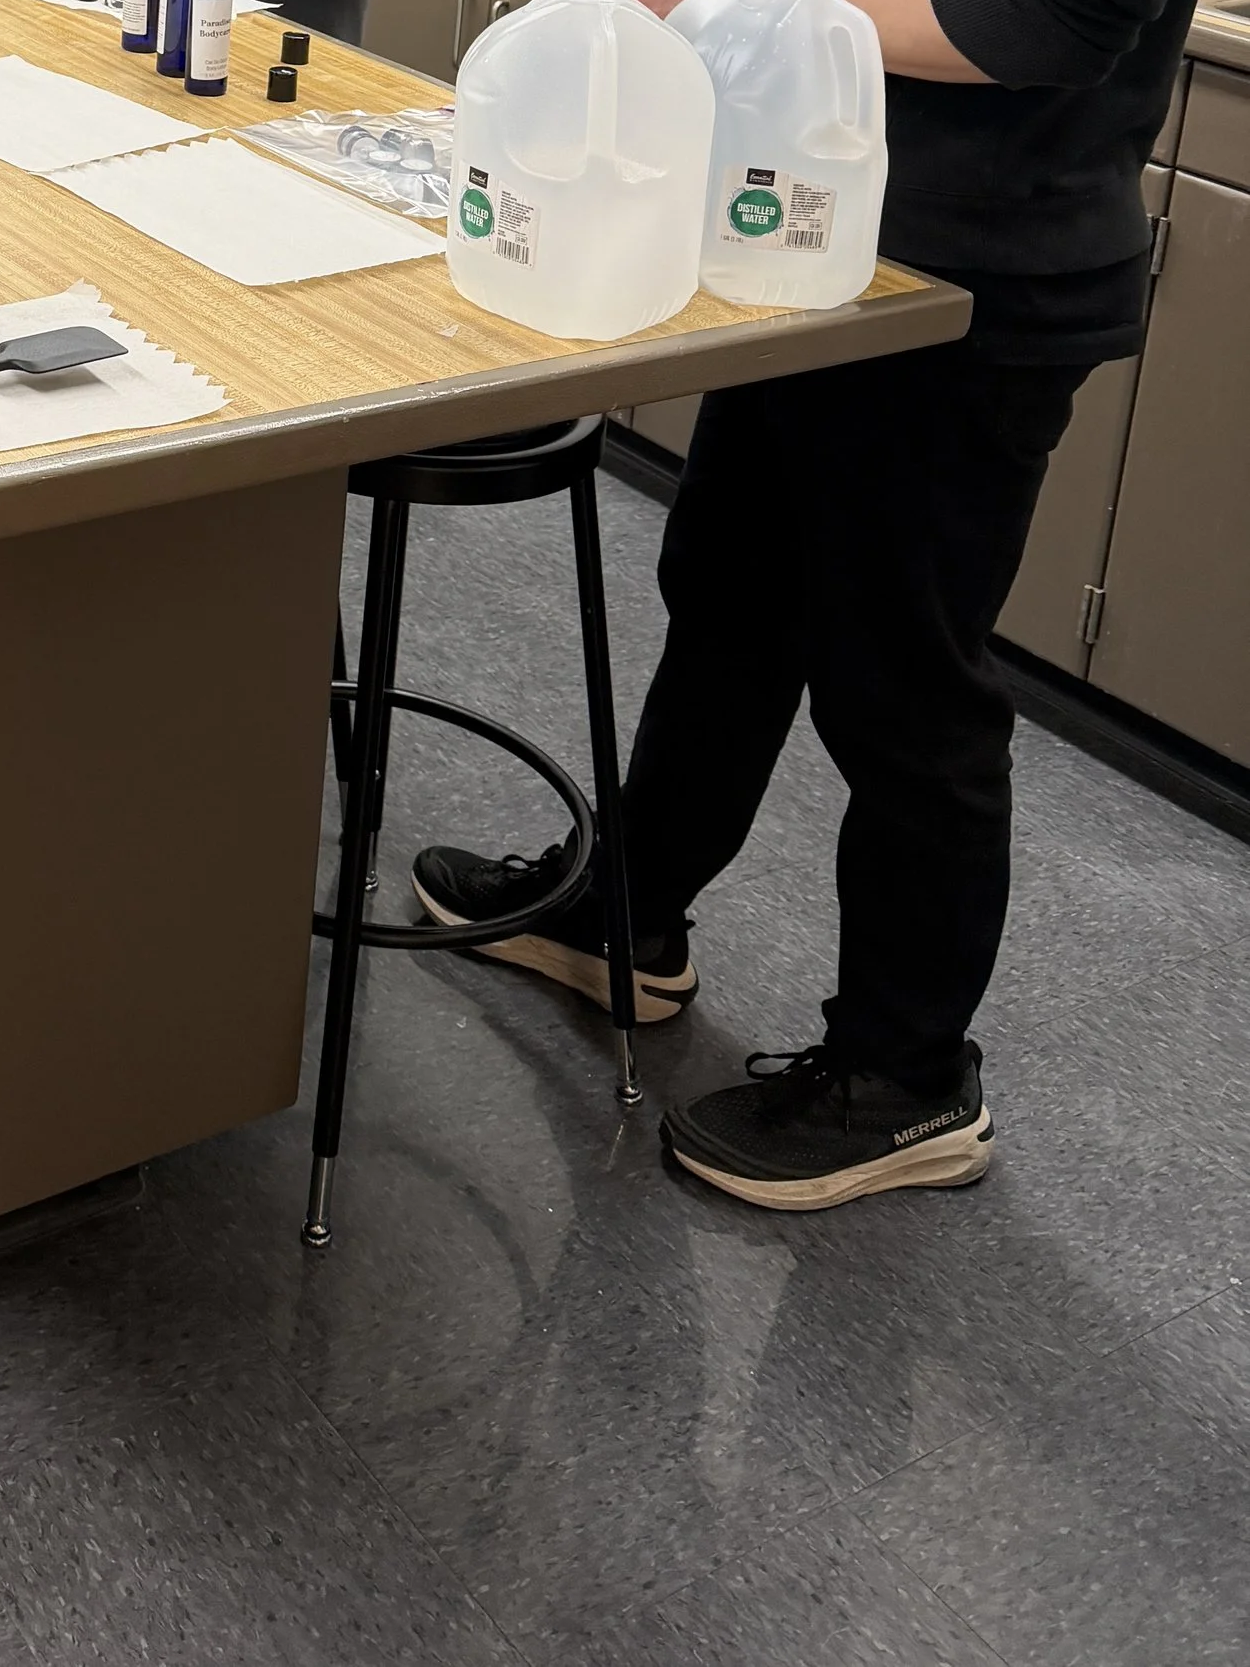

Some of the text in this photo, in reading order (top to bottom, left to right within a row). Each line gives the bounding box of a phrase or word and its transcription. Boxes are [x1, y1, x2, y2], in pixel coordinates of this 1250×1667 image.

[463, 200, 489, 220] DISTILLED
[737, 202, 776, 216] DISTILLED
[465, 213, 484, 228] WATER
[741, 213, 769, 225] WATER
[893, 1106, 968, 1146] MERRELL
